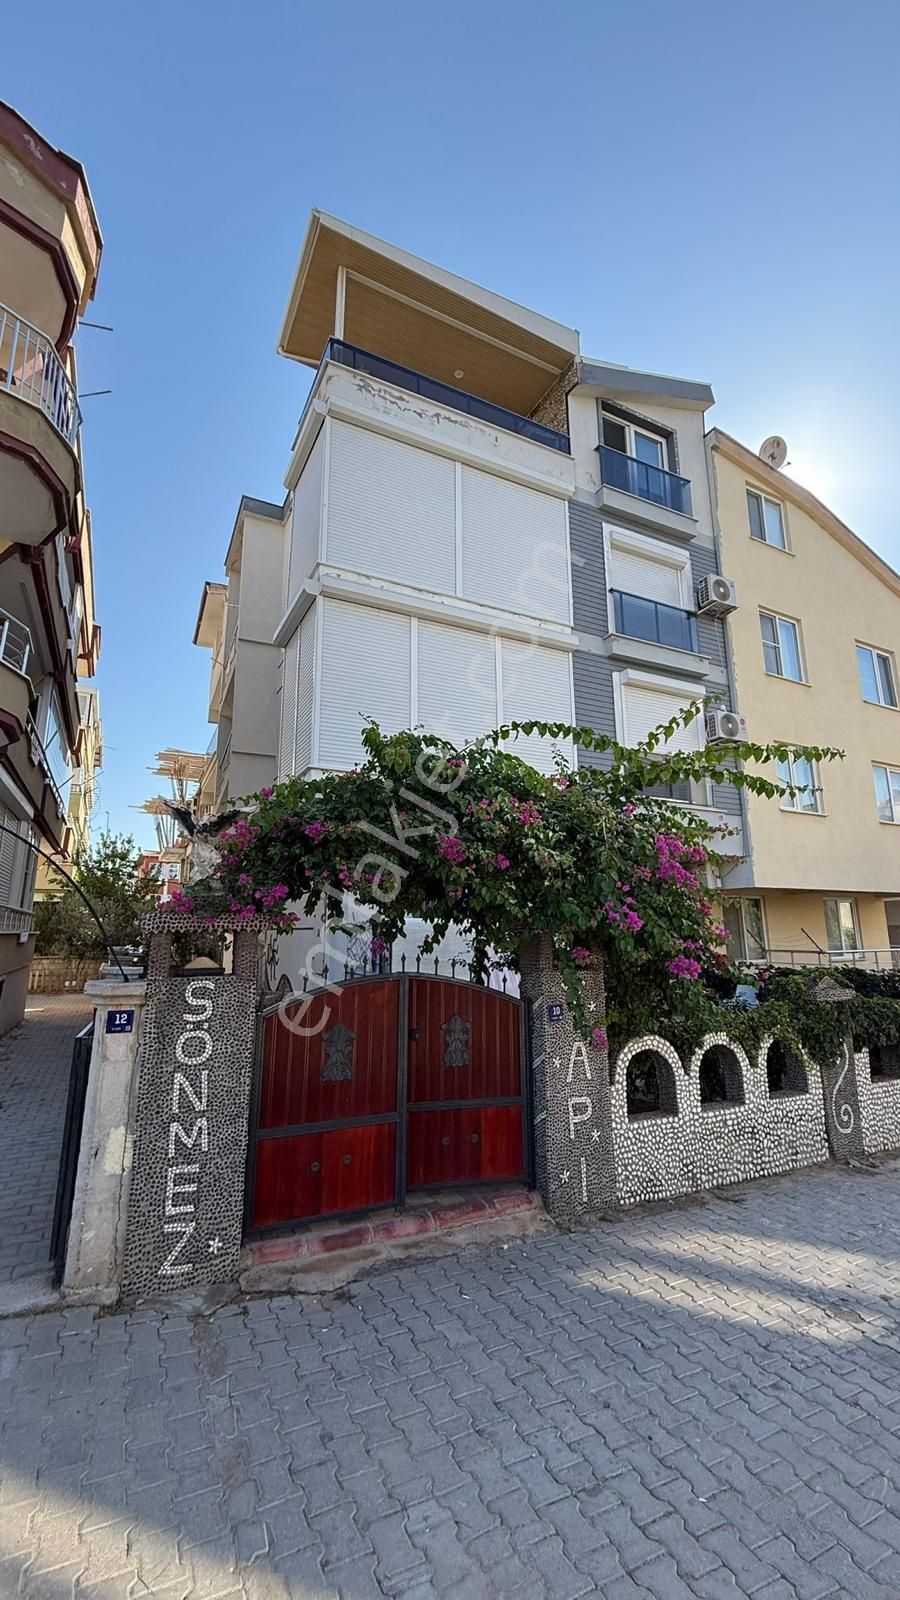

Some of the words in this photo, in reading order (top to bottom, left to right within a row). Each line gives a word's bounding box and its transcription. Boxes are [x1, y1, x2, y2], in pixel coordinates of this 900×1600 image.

[552, 1006, 560, 1015] 10
[115, 1014, 128, 1024] 12
[158, 980, 215, 1276] SÖNMEZ
